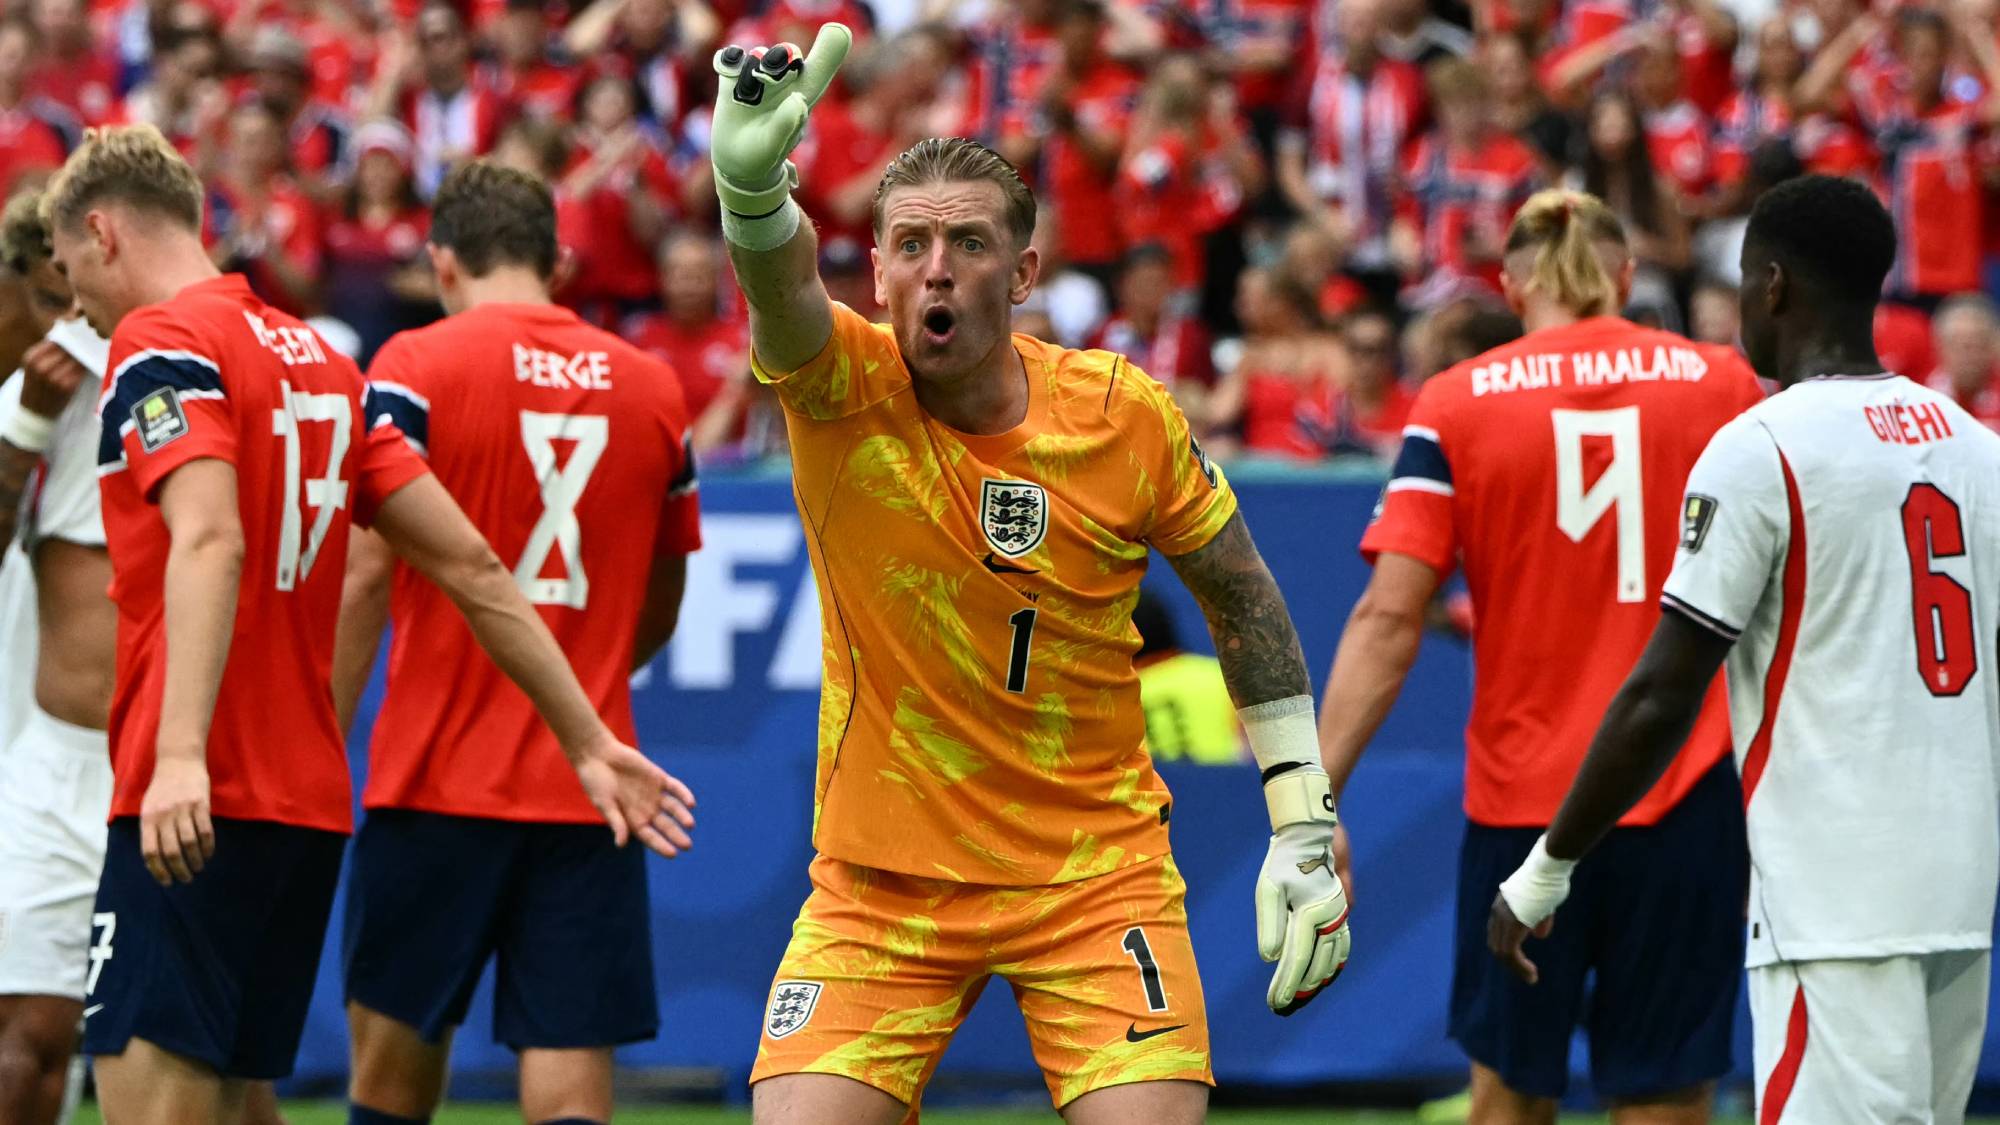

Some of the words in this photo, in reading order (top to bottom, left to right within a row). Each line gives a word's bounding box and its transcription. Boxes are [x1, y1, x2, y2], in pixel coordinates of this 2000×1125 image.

[512, 342, 612, 390] BERGE
[1471, 353, 1562, 397] BRAUT
[1572, 346, 1708, 384] HAALAND
[272, 379, 352, 591] 17
[513, 410, 609, 610] 8
[1551, 405, 1645, 603] 9
[1006, 607, 1038, 694] 1
[1901, 482, 1977, 697] 6
[1121, 926, 1169, 1013] 1
